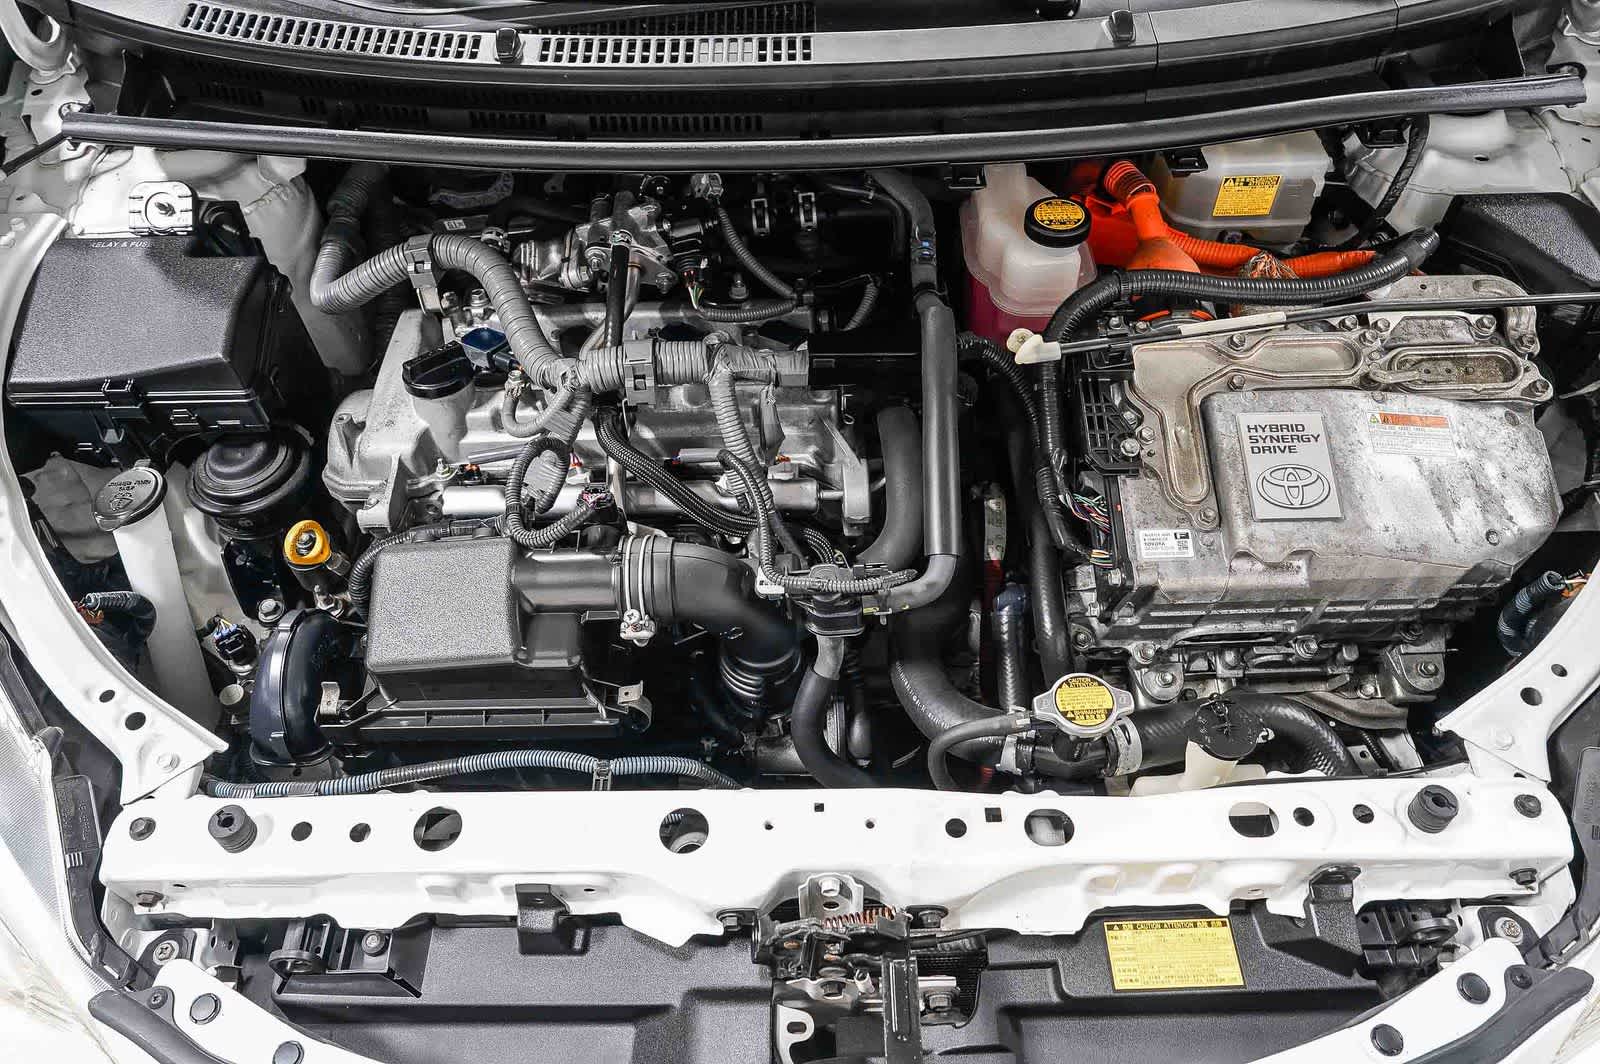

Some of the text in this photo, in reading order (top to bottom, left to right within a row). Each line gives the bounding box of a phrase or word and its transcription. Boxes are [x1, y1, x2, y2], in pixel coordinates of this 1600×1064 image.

[1247, 423, 1305, 433] HYBRID
[1248, 434, 1320, 444] SYNERGY
[1250, 445, 1298, 454] DRIVE
[1136, 922, 1161, 930] CAUTION
[1163, 921, 1194, 929] ATTENTION
